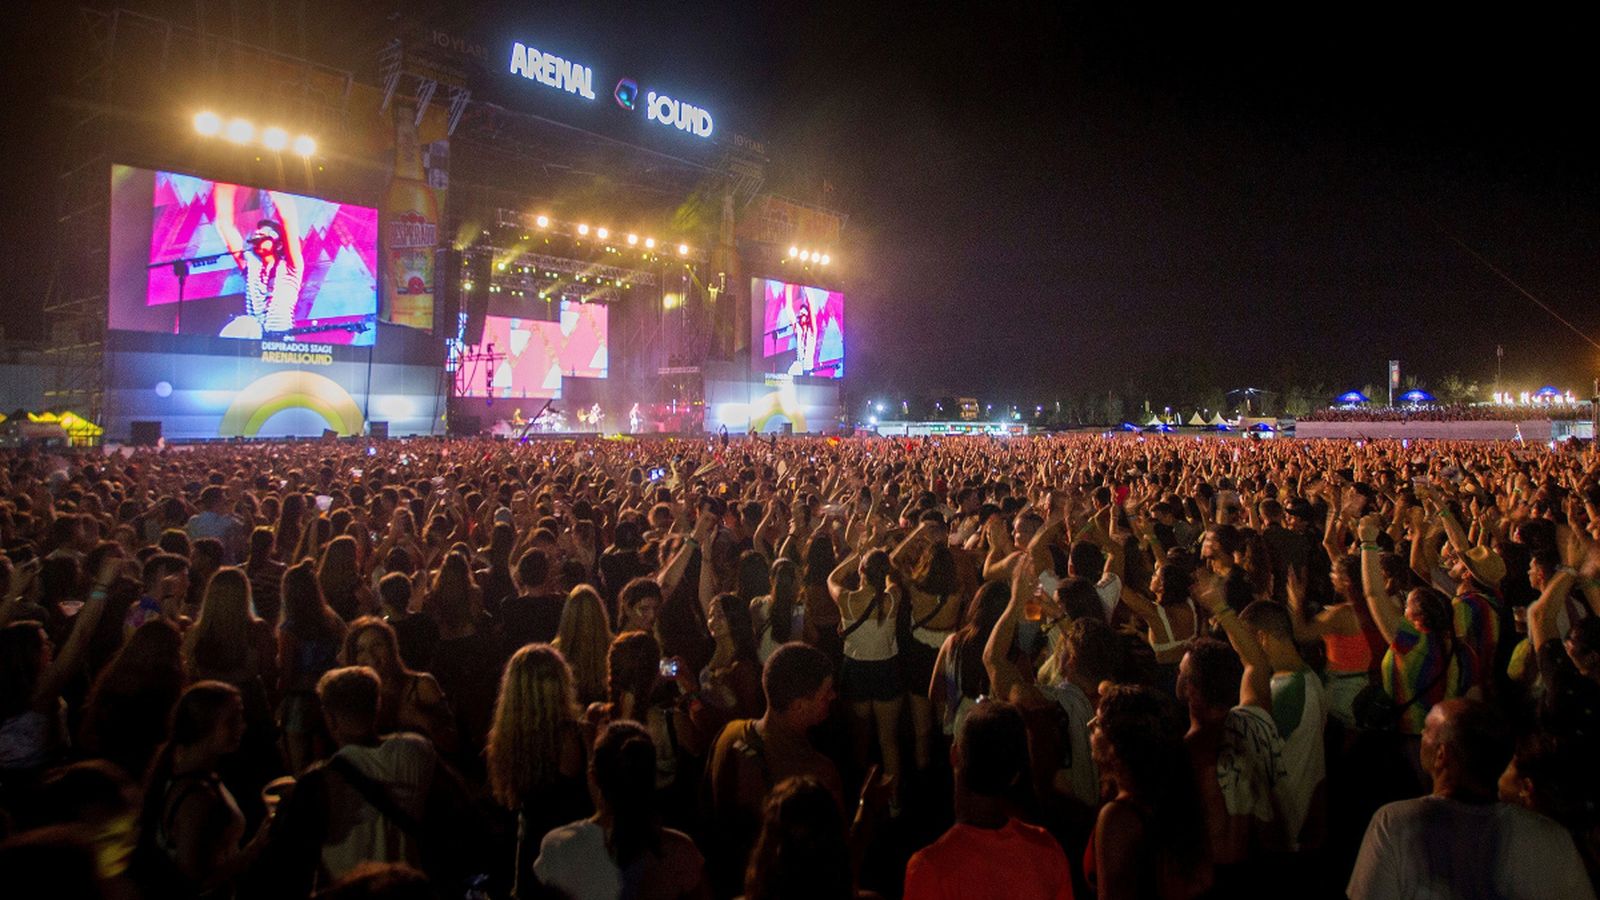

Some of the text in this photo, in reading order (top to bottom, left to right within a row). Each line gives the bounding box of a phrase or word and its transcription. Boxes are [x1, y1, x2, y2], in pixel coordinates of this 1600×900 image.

[432, 30, 450, 47] 10
[510, 42, 595, 100] ARENAL
[647, 91, 713, 138] SOUND
[261, 341, 333, 354] DESPERADOS STAGE
[261, 351, 333, 365] ARENALSOUND
